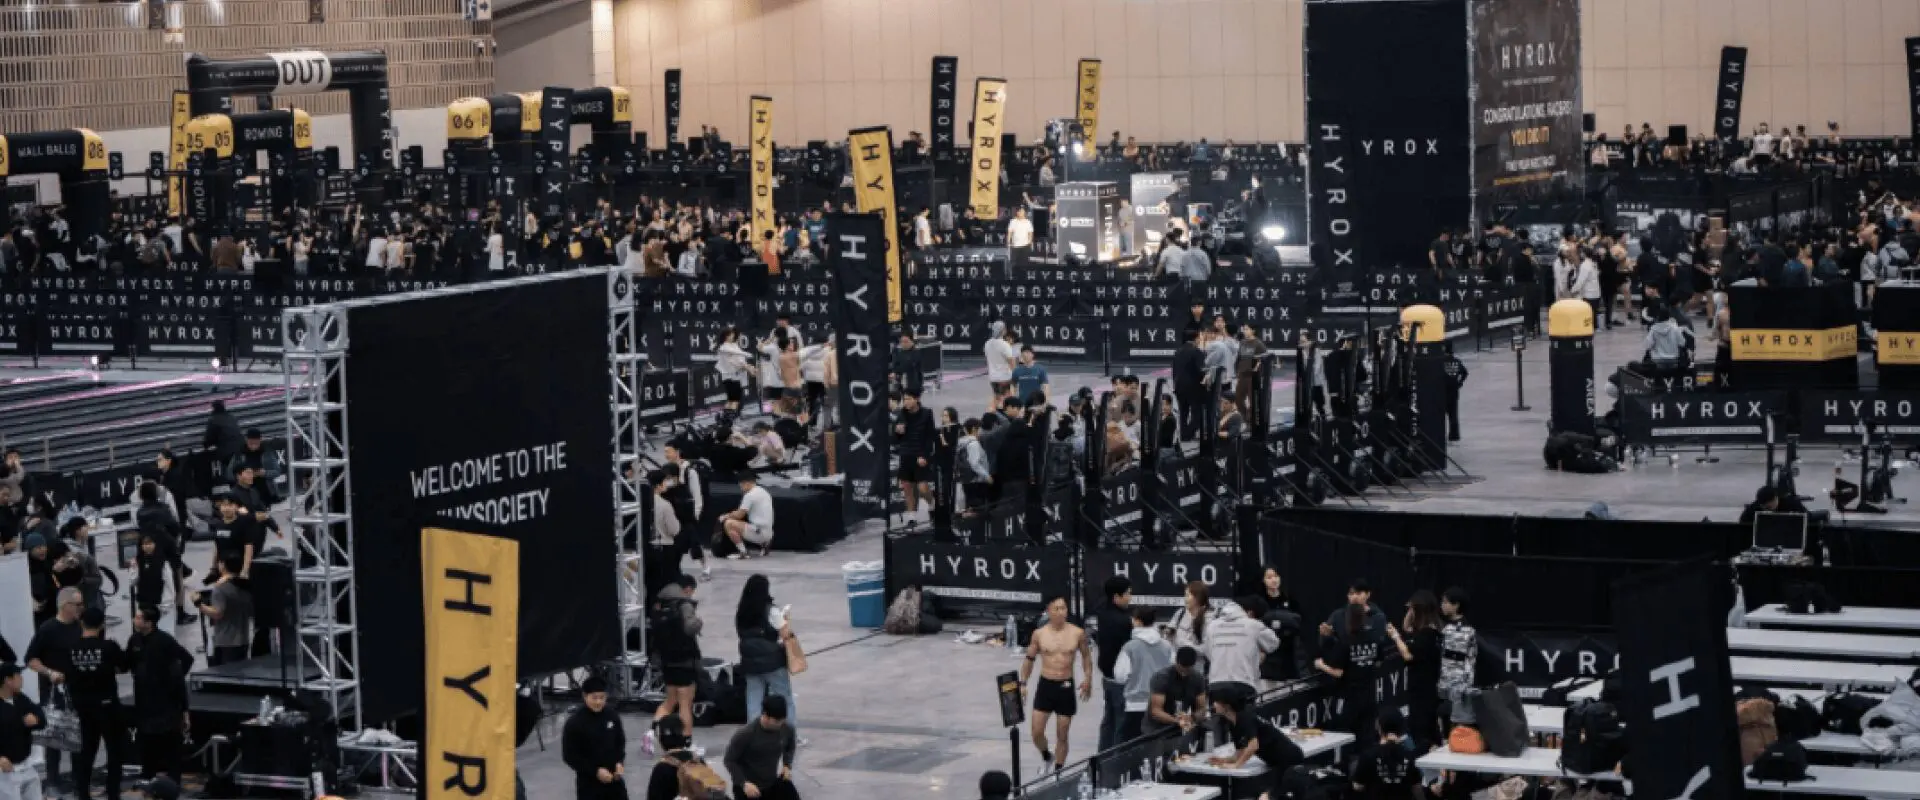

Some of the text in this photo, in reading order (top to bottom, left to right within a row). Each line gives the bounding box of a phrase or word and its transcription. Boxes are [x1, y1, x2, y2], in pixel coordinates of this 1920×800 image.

[1502, 42, 1556, 69] HYROX
[281, 59, 326, 86] OUT
[616, 98, 630, 112] 07
[939, 62, 952, 142] HYROX
[670, 82, 680, 142] HYRO
[380, 87, 393, 160] HYRO
[453, 114, 474, 129] 06
[244, 126, 283, 140] ROWING
[296, 121, 311, 138] 05
[215, 131, 231, 147] 05
[977, 90, 998, 193] HYROX
[18, 144, 43, 157] WALL
[46, 143, 76, 156] BALLS
[88, 142, 104, 159] 08
[1362, 139, 1438, 155] YROX
[755, 109, 769, 221] HYROX
[1321, 124, 1354, 267] HYROX
[928, 266, 992, 280] HYROX
[1376, 273, 1417, 286] ROX
[31, 278, 86, 289] HYROX
[117, 279, 174, 290] HYROX
[205, 279, 252, 291] HYRO
[295, 280, 355, 292] HYROX
[776, 283, 830, 296] HYRO
[909, 285, 947, 297] ROX
[985, 286, 1056, 299] HYROX
[1095, 286, 1168, 299] HYROX
[1207, 287, 1280, 300] HYROX
[5, 293, 37, 305] ROX
[70, 295, 128, 306] HYROX
[161, 296, 221, 308] HYROX
[653, 300, 721, 313] HYROX
[758, 300, 829, 314] HYROX
[980, 303, 1052, 317] HYROX
[1094, 304, 1169, 317] HYROX
[1213, 306, 1290, 320] HYROX
[51, 326, 113, 339] HYROX
[149, 326, 215, 340] HYROX
[911, 324, 971, 339] YROX
[1129, 328, 1177, 343] HYR
[840, 234, 875, 454] HYROX
[1742, 335, 1813, 347] HYROX
[644, 382, 676, 401] ROX
[1651, 400, 1762, 420] HYROX
[410, 440, 567, 499] WELCOME TO THE
[101, 474, 143, 498] HYR
[919, 553, 1041, 581] HYROX
[1114, 561, 1218, 586] HYRO
[1505, 649, 1597, 674] HYR
[443, 568, 492, 797] HYR
